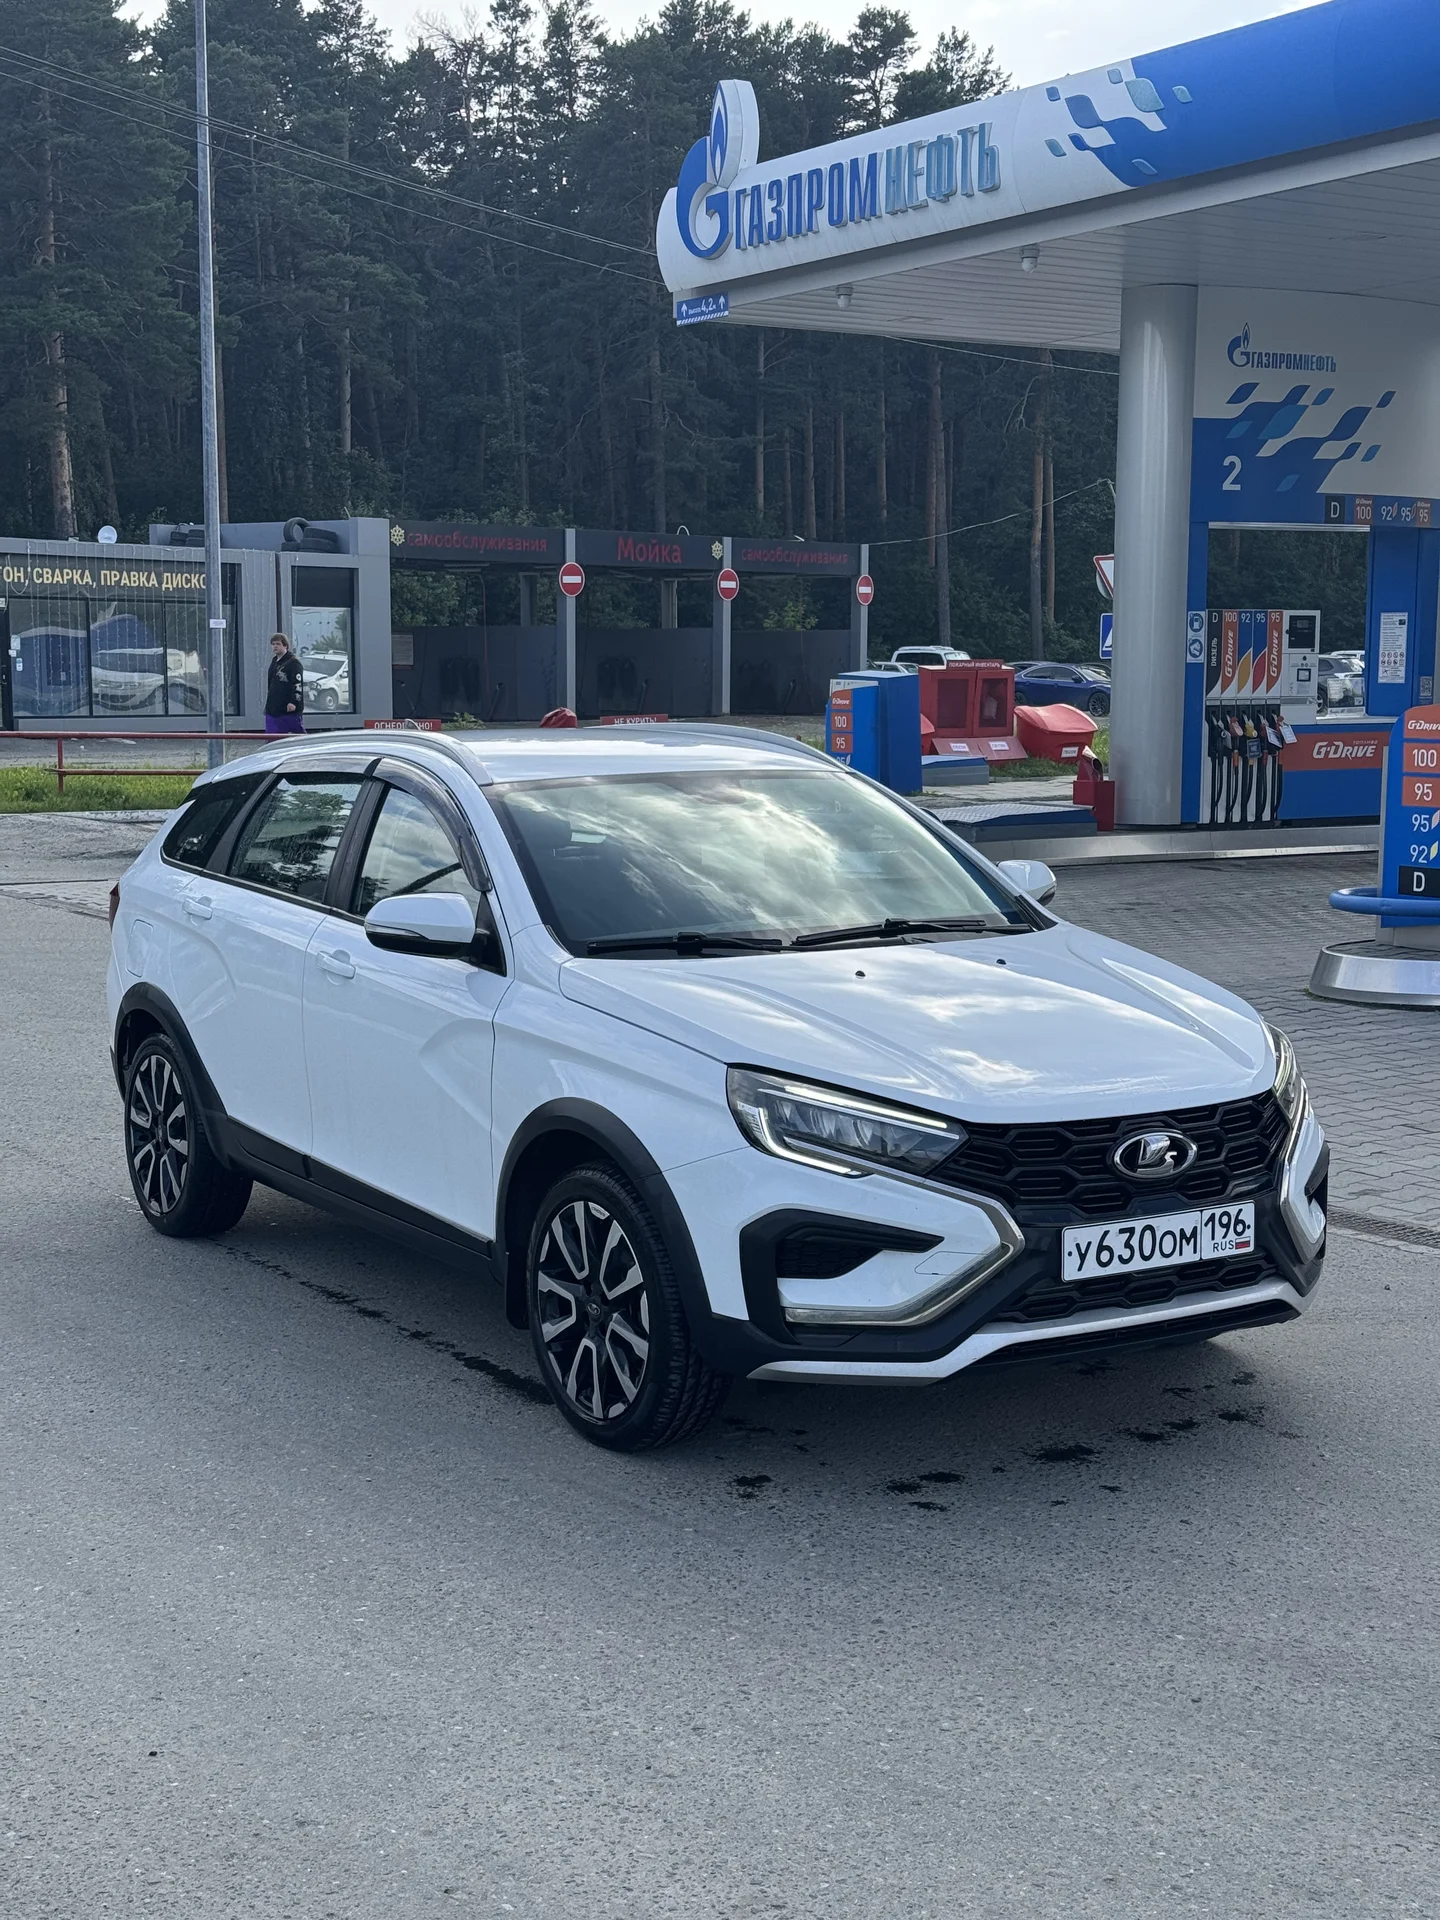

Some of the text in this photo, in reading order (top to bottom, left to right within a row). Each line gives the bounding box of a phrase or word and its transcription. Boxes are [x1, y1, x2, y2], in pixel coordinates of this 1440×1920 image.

[734, 122, 1000, 250] ГАЗПРОМНЕФТЬ
[1251, 351, 1337, 372] ГАЗПРОМНЕФТЬ
[1222, 455, 1242, 490] 2
[1330, 501, 1340, 518] D
[1355, 506, 1372, 520] 100
[1380, 505, 1393, 521] 92
[1400, 507, 1411, 522] 95
[1419, 509, 1429, 522] 95
[407, 530, 547, 554] самообслуживания
[616, 536, 682, 563] Мойка
[740, 547, 849, 567] самообслуживания
[0, 566, 29, 587] ОН,
[33, 567, 97, 589] СВАРКА,
[101, 570, 158, 588] ПРАВКА
[1212, 613, 1218, 623] D
[1224, 612, 1237, 622] 100
[1240, 613, 1251, 623] 92
[1256, 613, 1266, 623] 95
[1270, 612, 1280, 623] 95
[614, 716, 657, 725] НЕ КУРИТЬ!
[834, 715, 847, 728] 100
[836, 737, 846, 749] 95
[1412, 748, 1437, 767] 100
[1414, 783, 1433, 801] 95
[1412, 813, 1430, 832] 95
[1409, 844, 1428, 863] 92
[1412, 871, 1426, 892] D
[1075, 1208, 1247, 1272] У630ОМ 196
[1212, 1240, 1235, 1253] RUS
